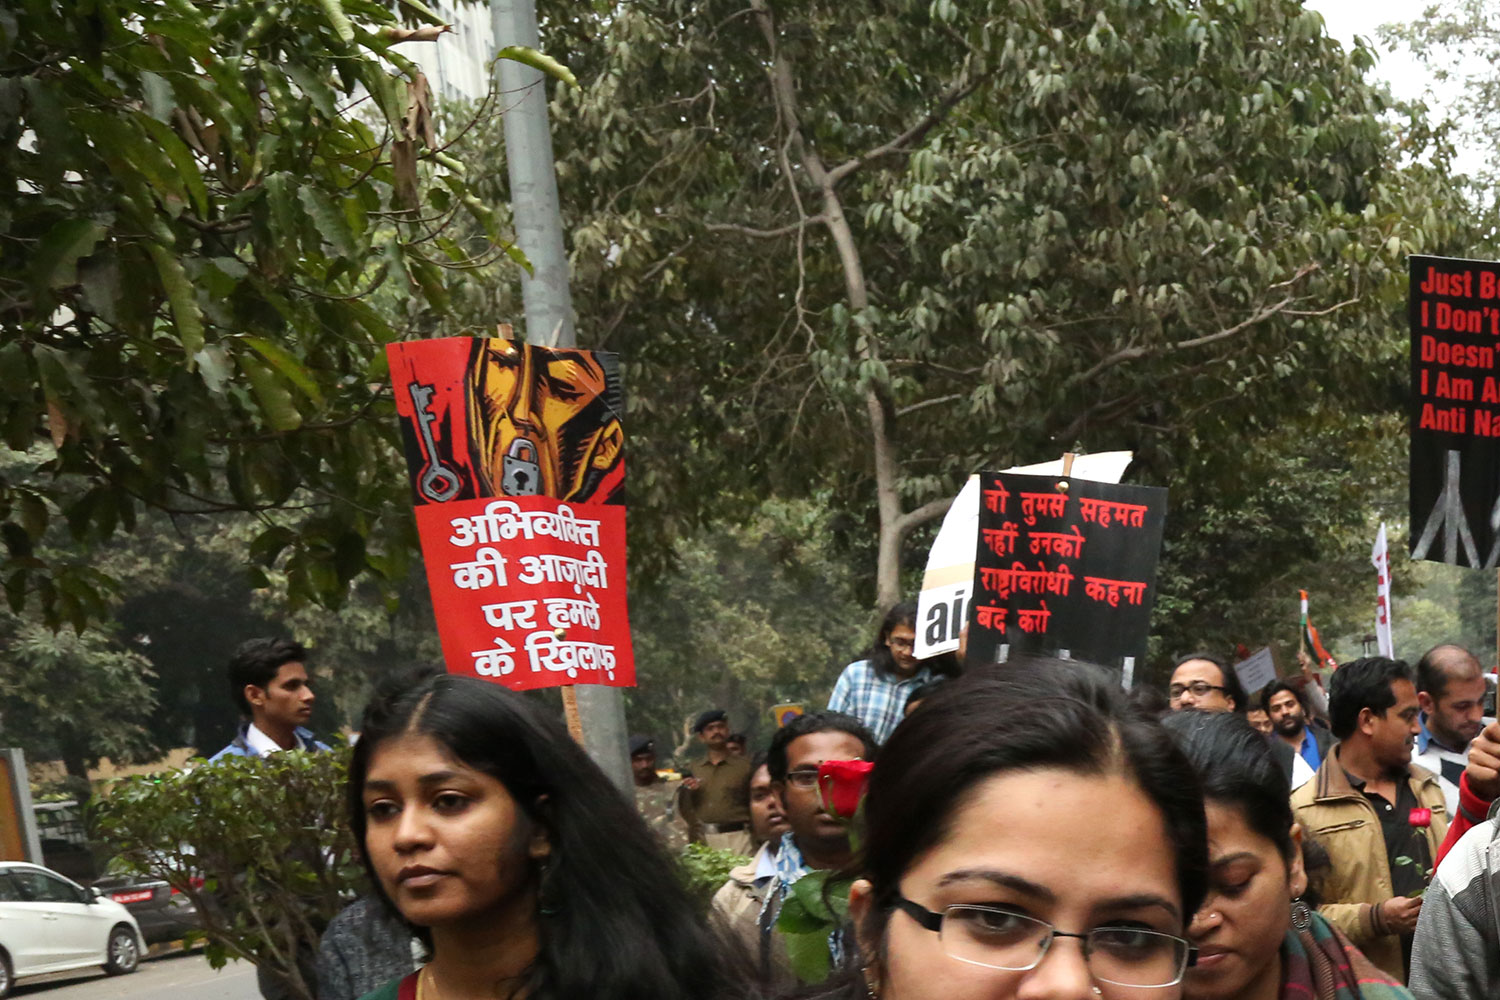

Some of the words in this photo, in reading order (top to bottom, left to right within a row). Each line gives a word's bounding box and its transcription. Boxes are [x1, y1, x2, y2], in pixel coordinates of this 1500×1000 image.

[1421, 267, 1472, 297] Just
[1422, 301, 1428, 326] I
[1437, 303, 1499, 335] Don't
[1421, 369, 1428, 395] I
[1436, 374, 1473, 400] Am
[1420, 404, 1465, 432] Anti
[450, 501, 602, 547] अभिव्यक्ति
[1078, 497, 1148, 529] सहमत
[982, 522, 1019, 557] नहीं
[1028, 525, 1086, 559] उनको
[450, 547, 507, 589] की
[519, 550, 607, 595] आज़ादी
[980, 561, 1074, 601] राष्ट्रविरोधी
[1084, 576, 1147, 607] कहना
[481, 600, 539, 631] पर
[543, 592, 600, 631] हमले
[926, 590, 971, 647] ai
[976, 598, 1008, 634] बंद
[1016, 599, 1052, 634] करो
[472, 637, 515, 677] के
